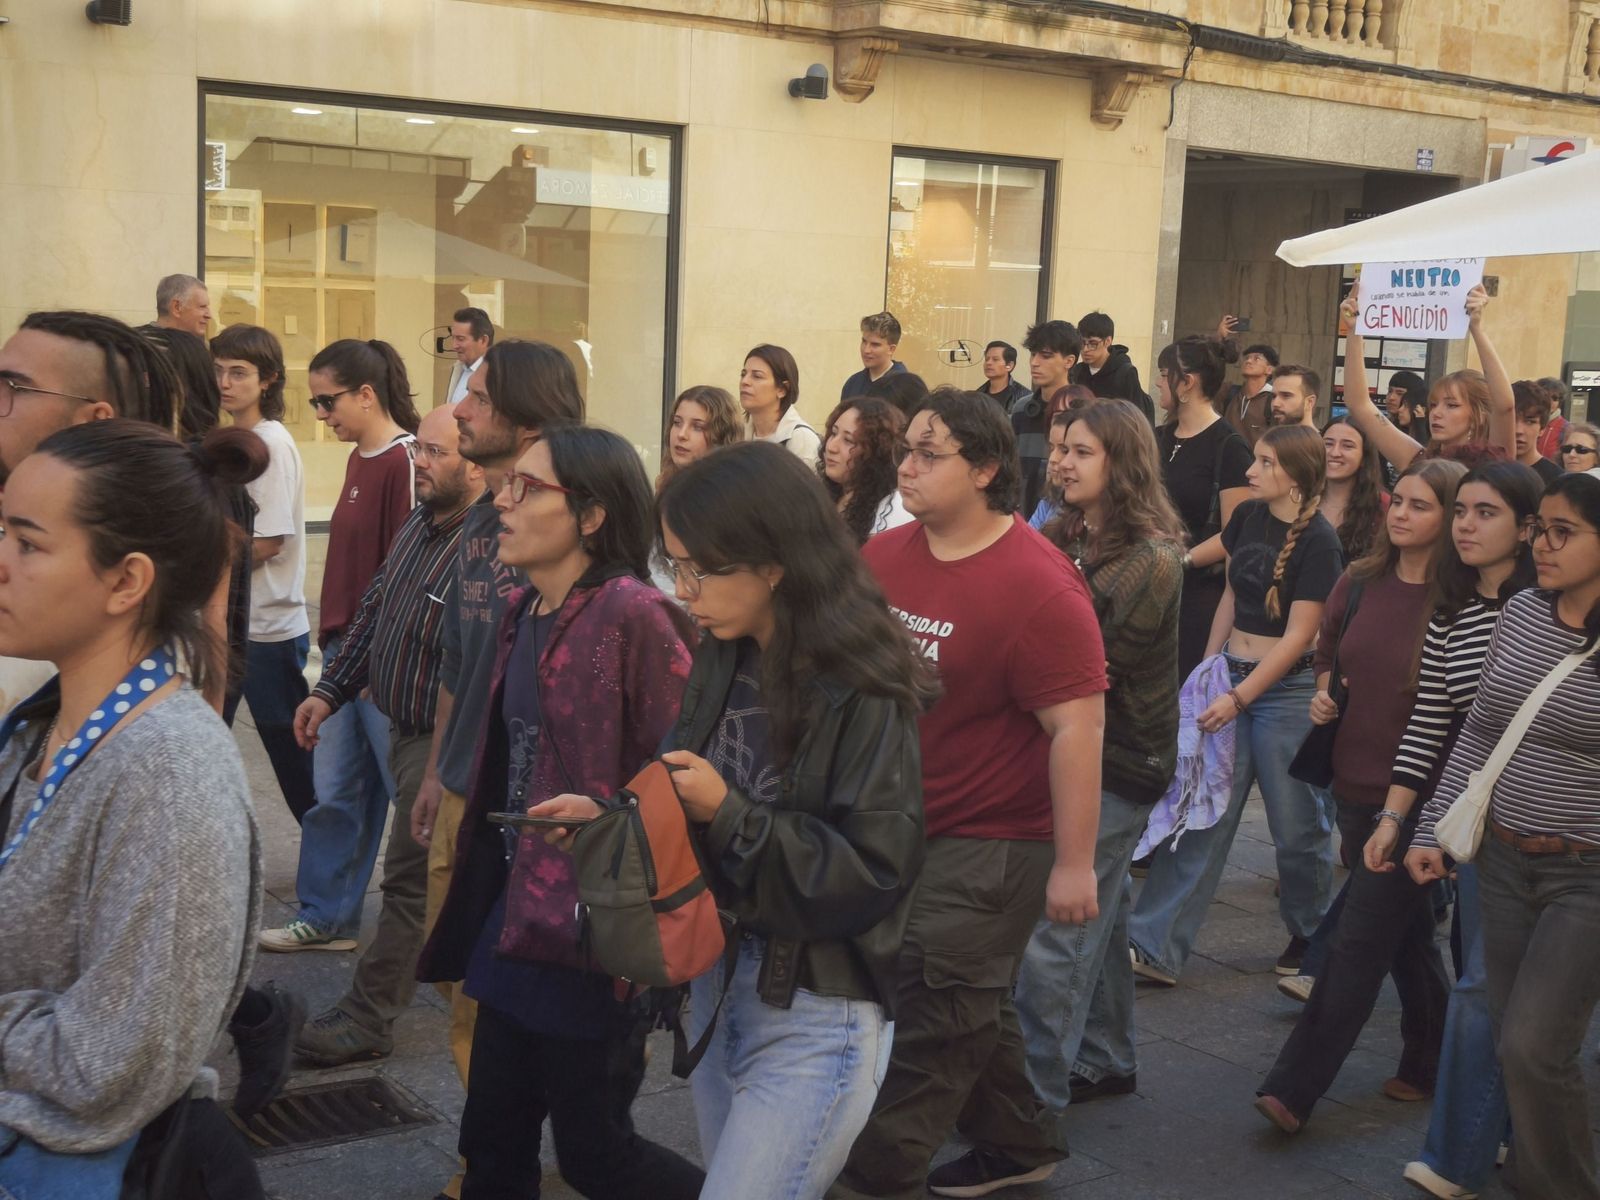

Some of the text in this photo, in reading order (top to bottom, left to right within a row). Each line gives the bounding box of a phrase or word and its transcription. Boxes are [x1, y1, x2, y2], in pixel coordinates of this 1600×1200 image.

[1391, 266, 1461, 288] NEUTRO
[1406, 290, 1425, 298] habla
[888, 605, 954, 637] RSIDAD
